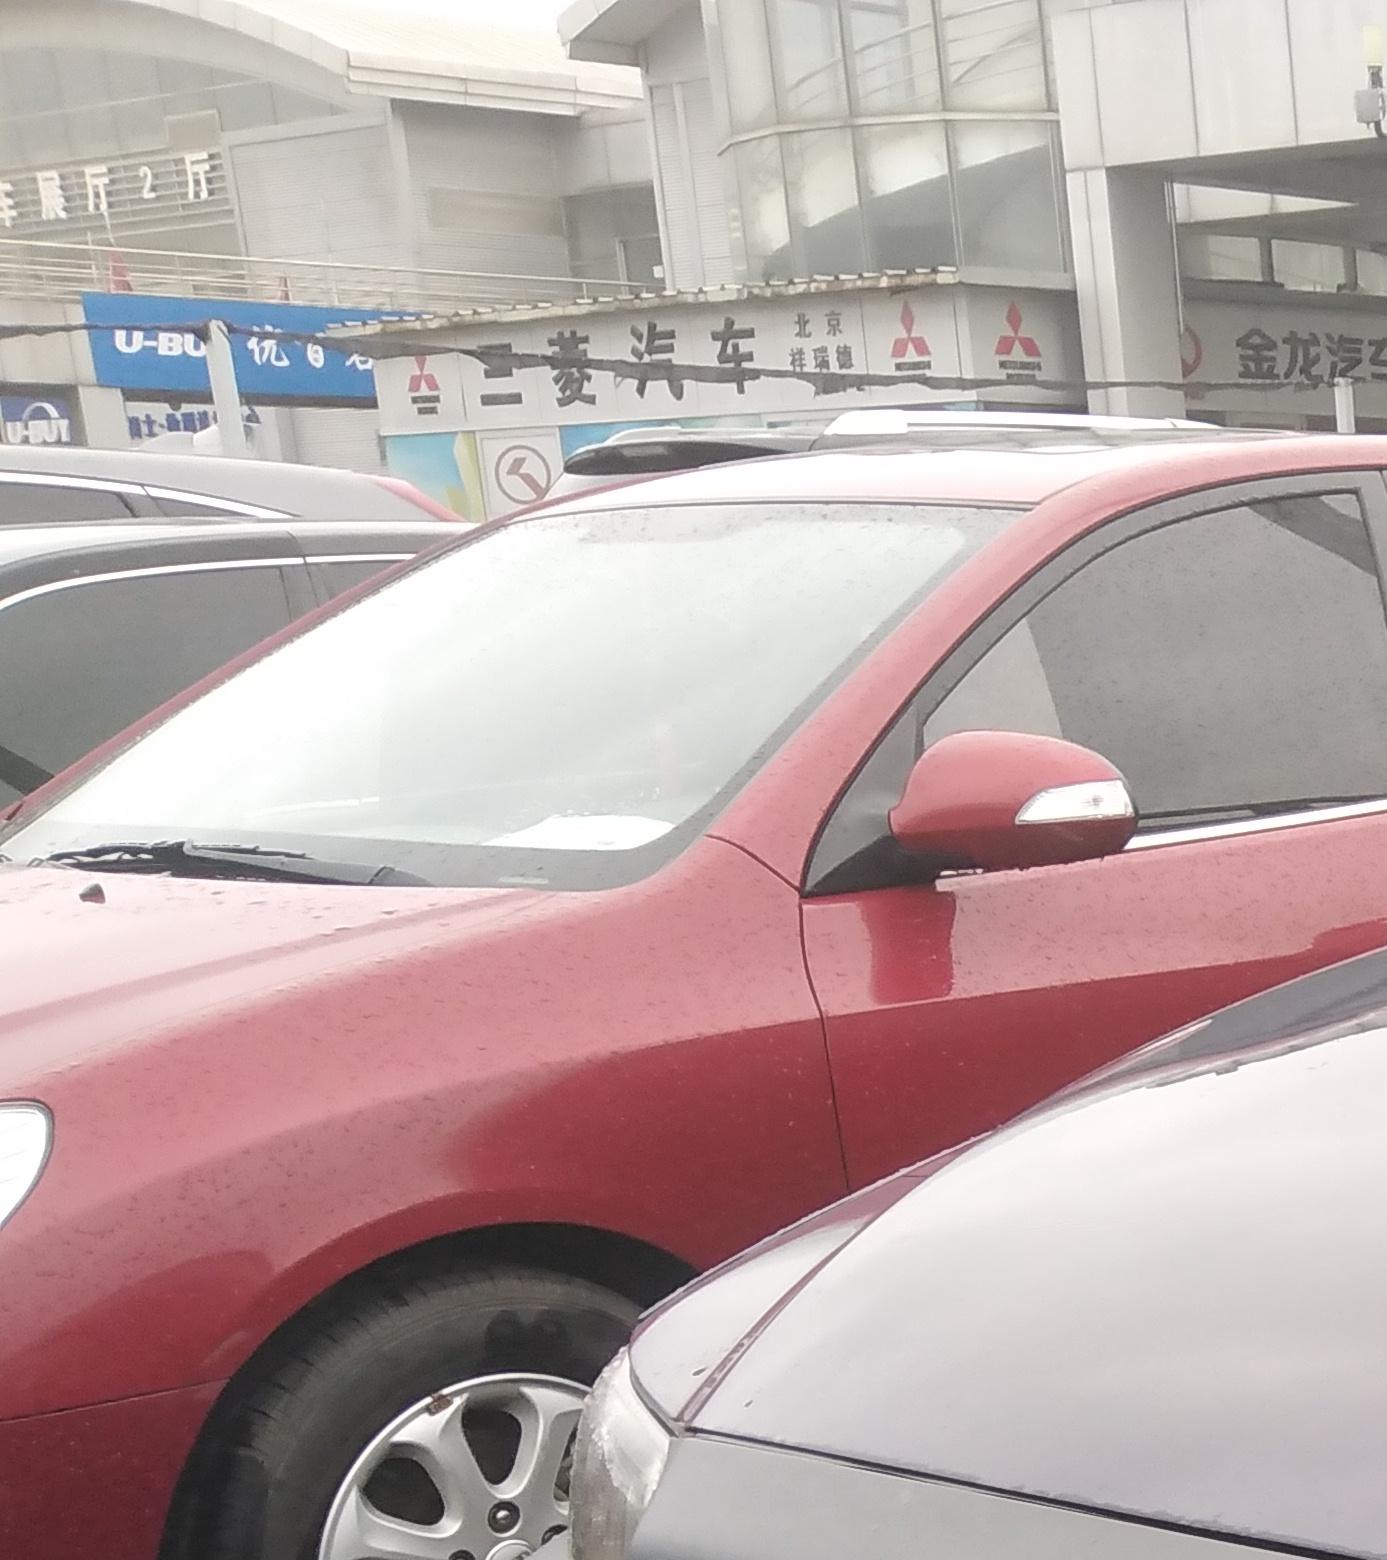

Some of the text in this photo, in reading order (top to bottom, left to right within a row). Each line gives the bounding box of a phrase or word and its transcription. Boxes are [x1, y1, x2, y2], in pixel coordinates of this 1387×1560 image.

[794, 309, 843, 338] 北京
[114, 328, 208, 358] U-BU
[476, 316, 756, 408] 三菱汽车
